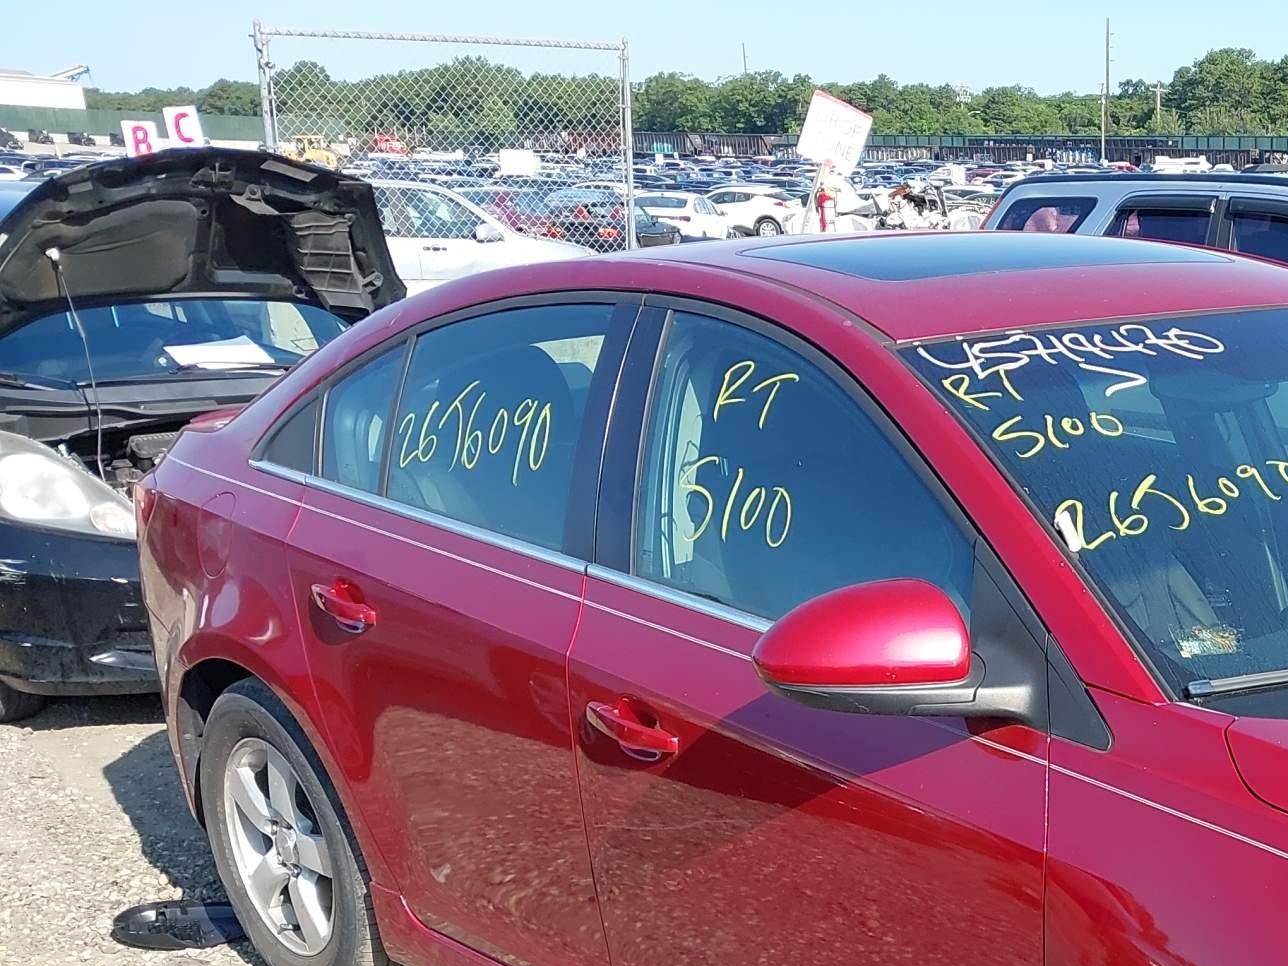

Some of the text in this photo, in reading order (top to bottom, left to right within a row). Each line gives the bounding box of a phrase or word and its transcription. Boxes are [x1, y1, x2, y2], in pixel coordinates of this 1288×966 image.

[174, 112, 194, 143] C
[714, 361, 799, 428] RT
[942, 368, 1024, 411] RT
